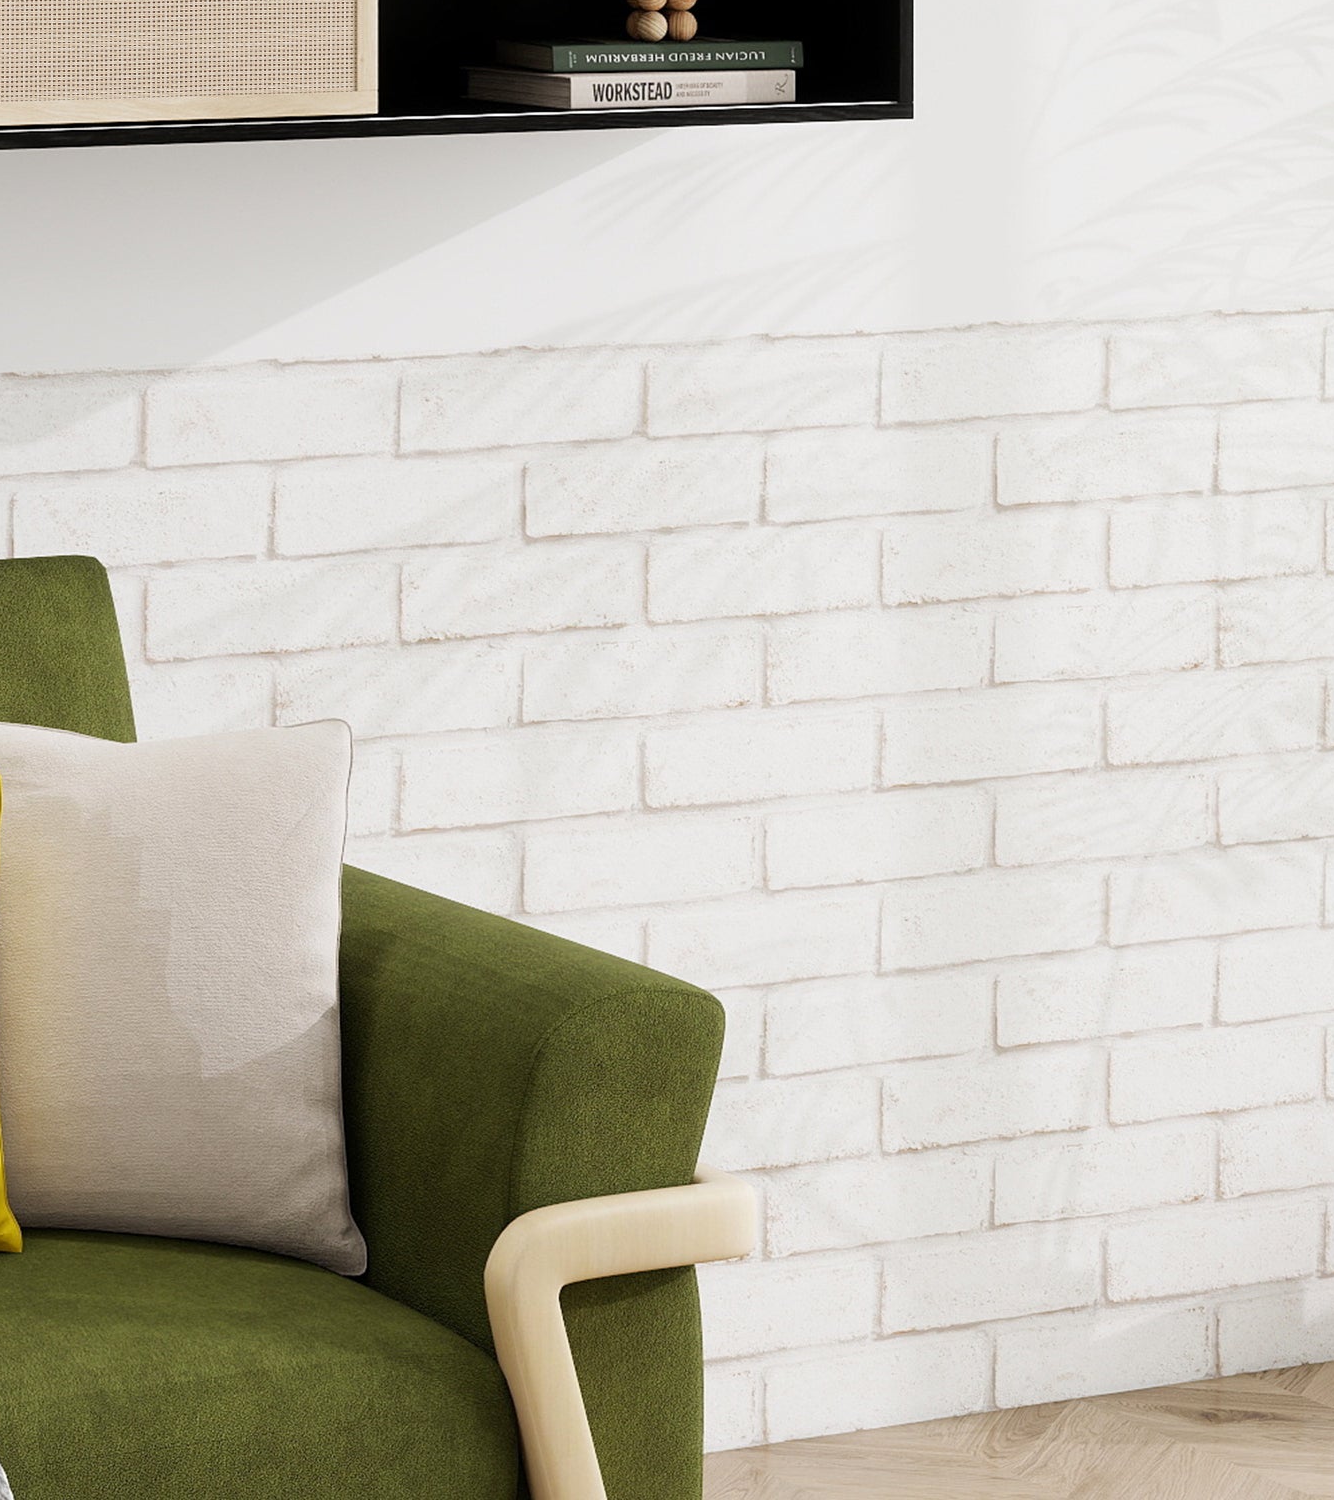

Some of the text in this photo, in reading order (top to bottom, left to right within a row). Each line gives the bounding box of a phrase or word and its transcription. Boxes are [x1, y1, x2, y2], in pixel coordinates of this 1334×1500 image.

[585, 53, 665, 63] HERBARIUM
[668, 52, 712, 62] FREUD
[715, 51, 766, 61] LUCIAN
[592, 81, 673, 102] WORKSTEAD
